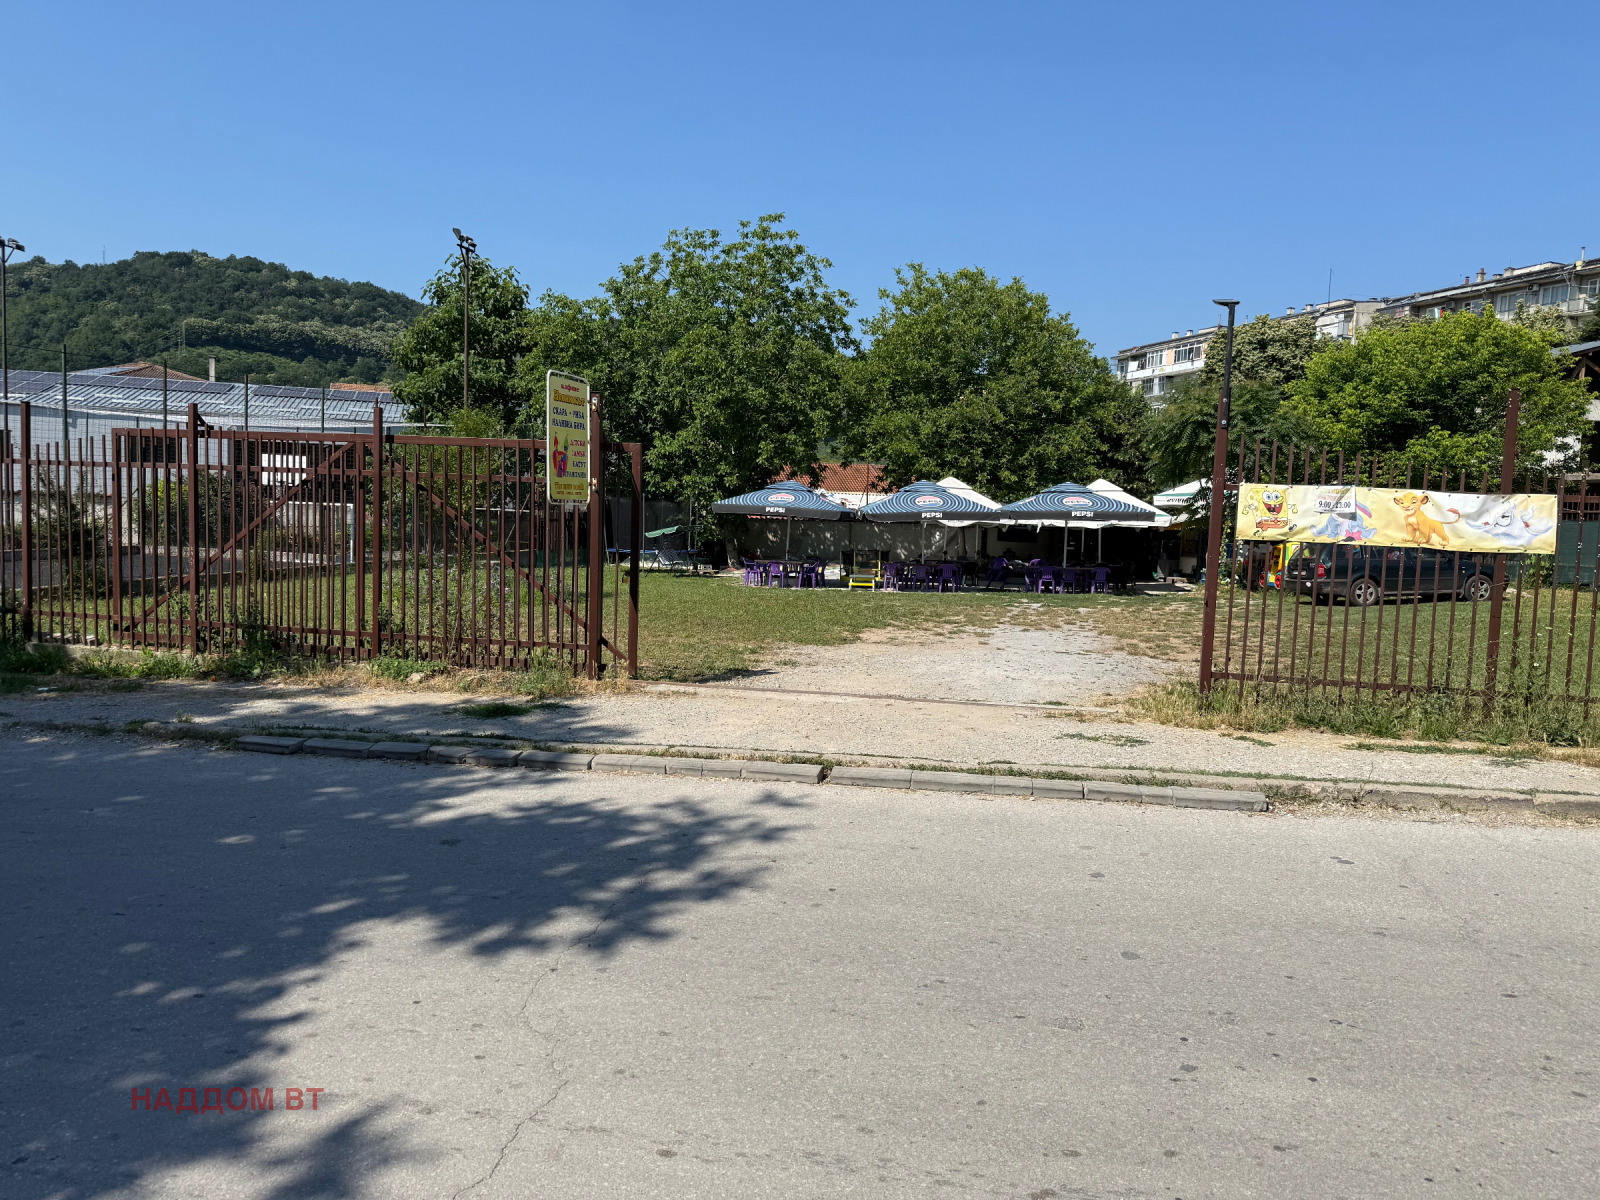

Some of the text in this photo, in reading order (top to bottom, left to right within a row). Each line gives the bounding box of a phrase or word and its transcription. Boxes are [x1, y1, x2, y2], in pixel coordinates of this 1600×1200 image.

[553, 407, 568, 416] СКАРА
[573, 410, 585, 420] РИБА
[574, 422, 585, 430] БИРА
[1318, 500, 1331, 509] 9.00
